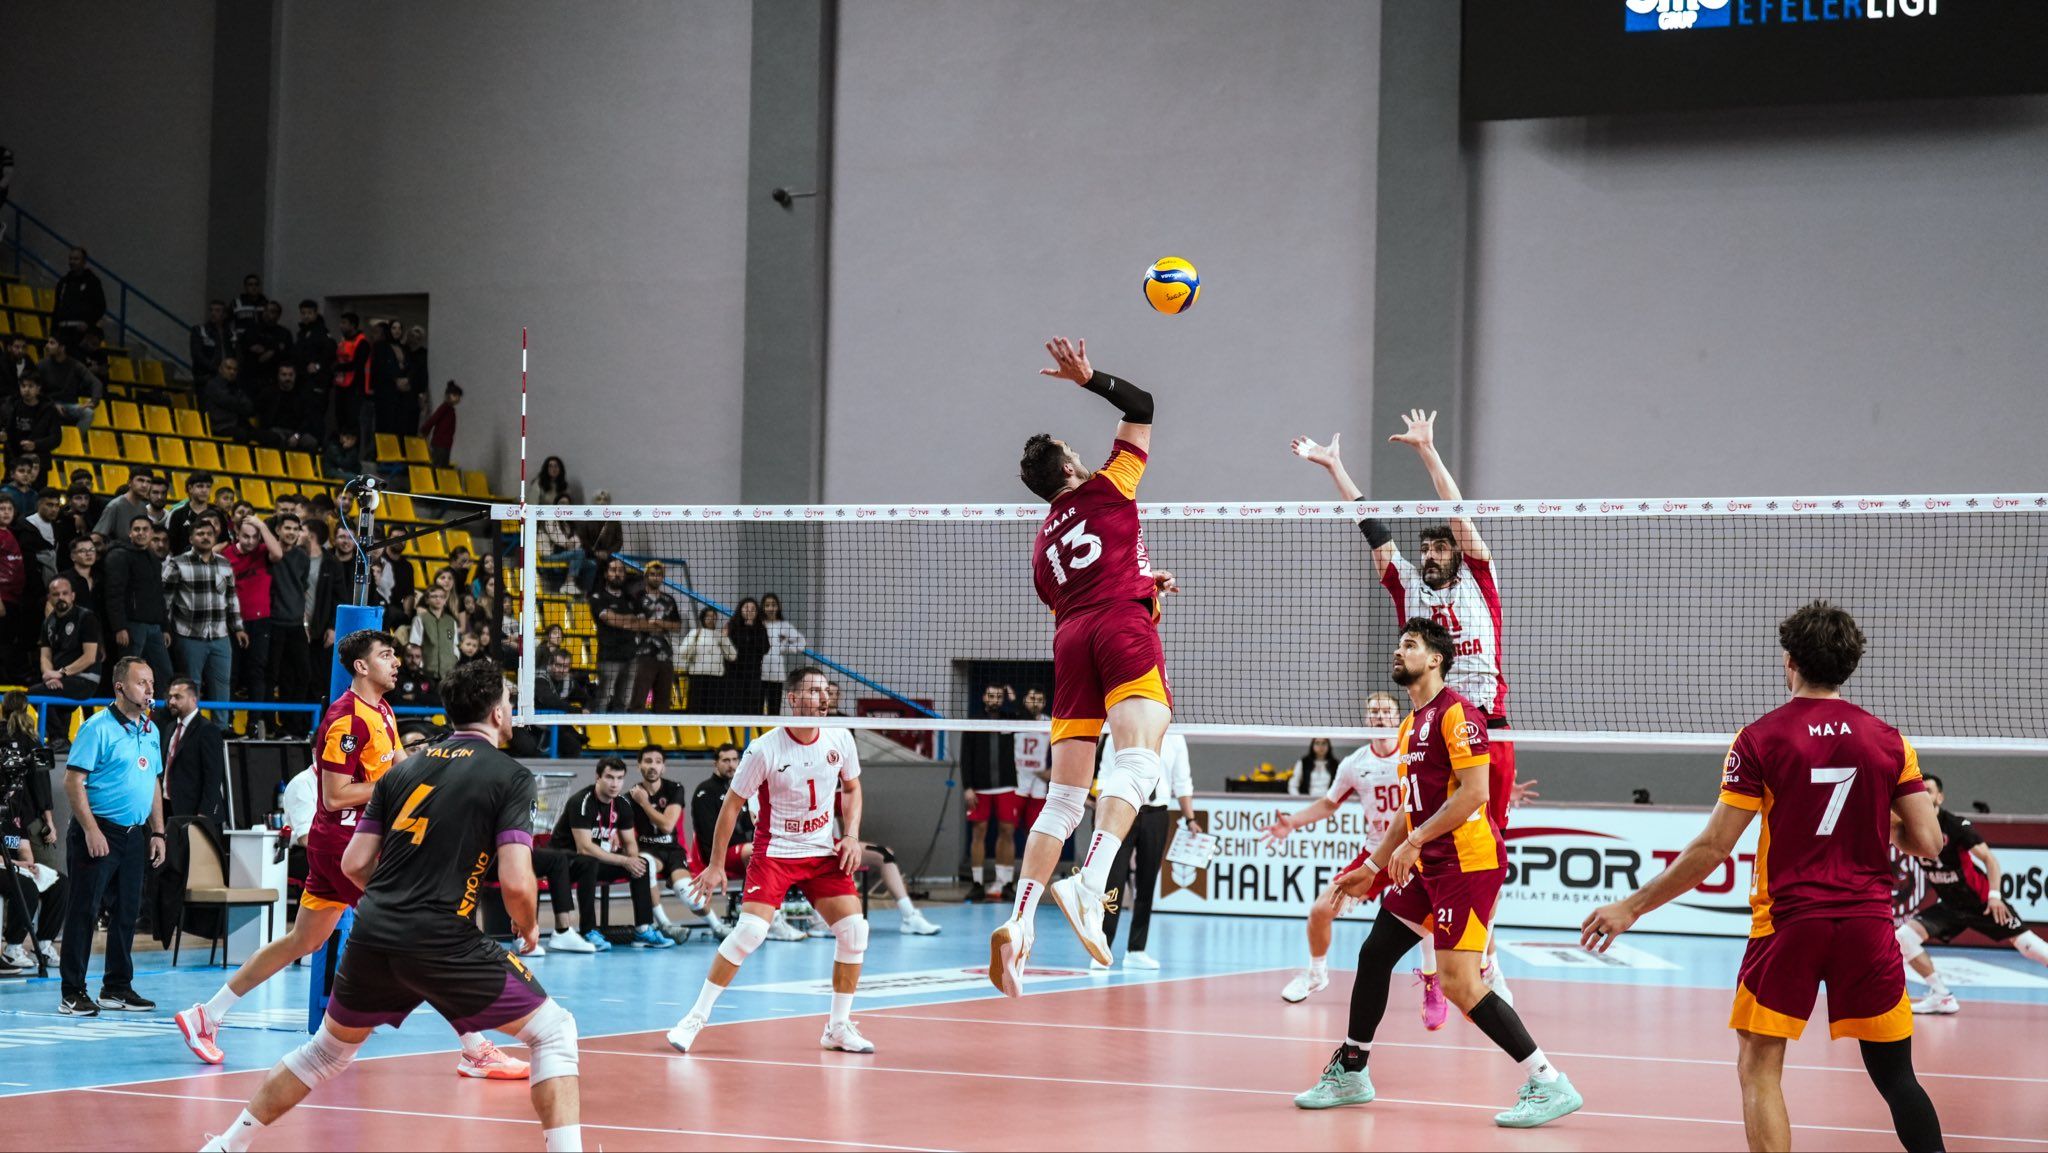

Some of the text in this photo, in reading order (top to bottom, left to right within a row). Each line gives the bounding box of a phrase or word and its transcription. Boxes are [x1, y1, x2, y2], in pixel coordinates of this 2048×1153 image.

[1043, 507, 1077, 537] MAAR
[1046, 519, 1102, 585] 13
[1453, 638, 1483, 657] RCA
[1808, 722, 1852, 736] MA'A
[807, 778, 817, 811] 1
[1374, 784, 1401, 813] 50
[1400, 773, 1423, 813] 21
[1811, 767, 1858, 836] 7
[391, 783, 436, 845] 4
[1214, 863, 1304, 903] HALK
[1438, 908, 1453, 922] 21
